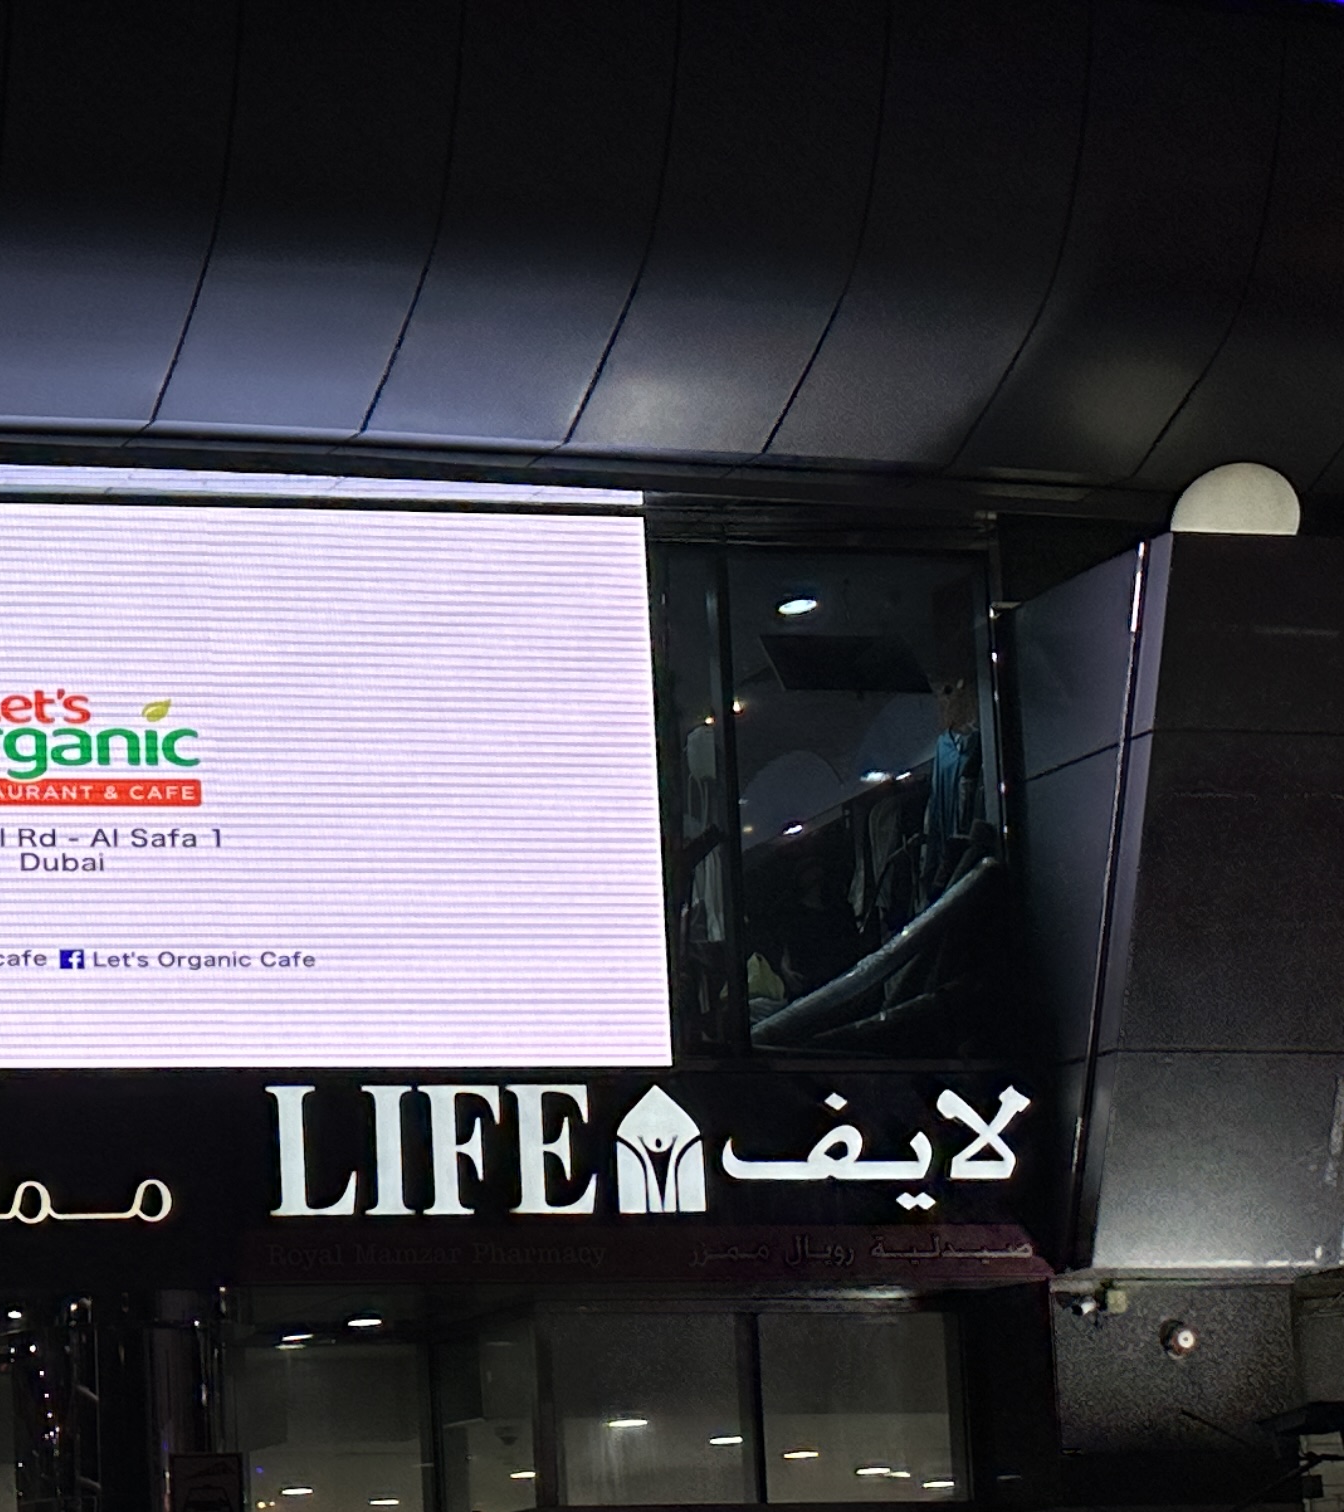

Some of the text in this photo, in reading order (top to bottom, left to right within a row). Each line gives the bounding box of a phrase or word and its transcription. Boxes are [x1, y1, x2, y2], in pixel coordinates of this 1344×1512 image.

[103, 784, 119, 801] &
[129, 785, 196, 802] CAFE
[17, 828, 58, 849] Rd
[89, 828, 119, 849] Al
[130, 828, 198, 849] Safa
[211, 828, 222, 848] 1
[19, 853, 105, 873] Dubai
[92, 951, 316, 971] Let's Organic Cafe
[264, 1083, 599, 1217] LIFE
[721, 1085, 1032, 1211] لايف
[268, 1242, 608, 1269] Royal Mamzar Pharmacy
